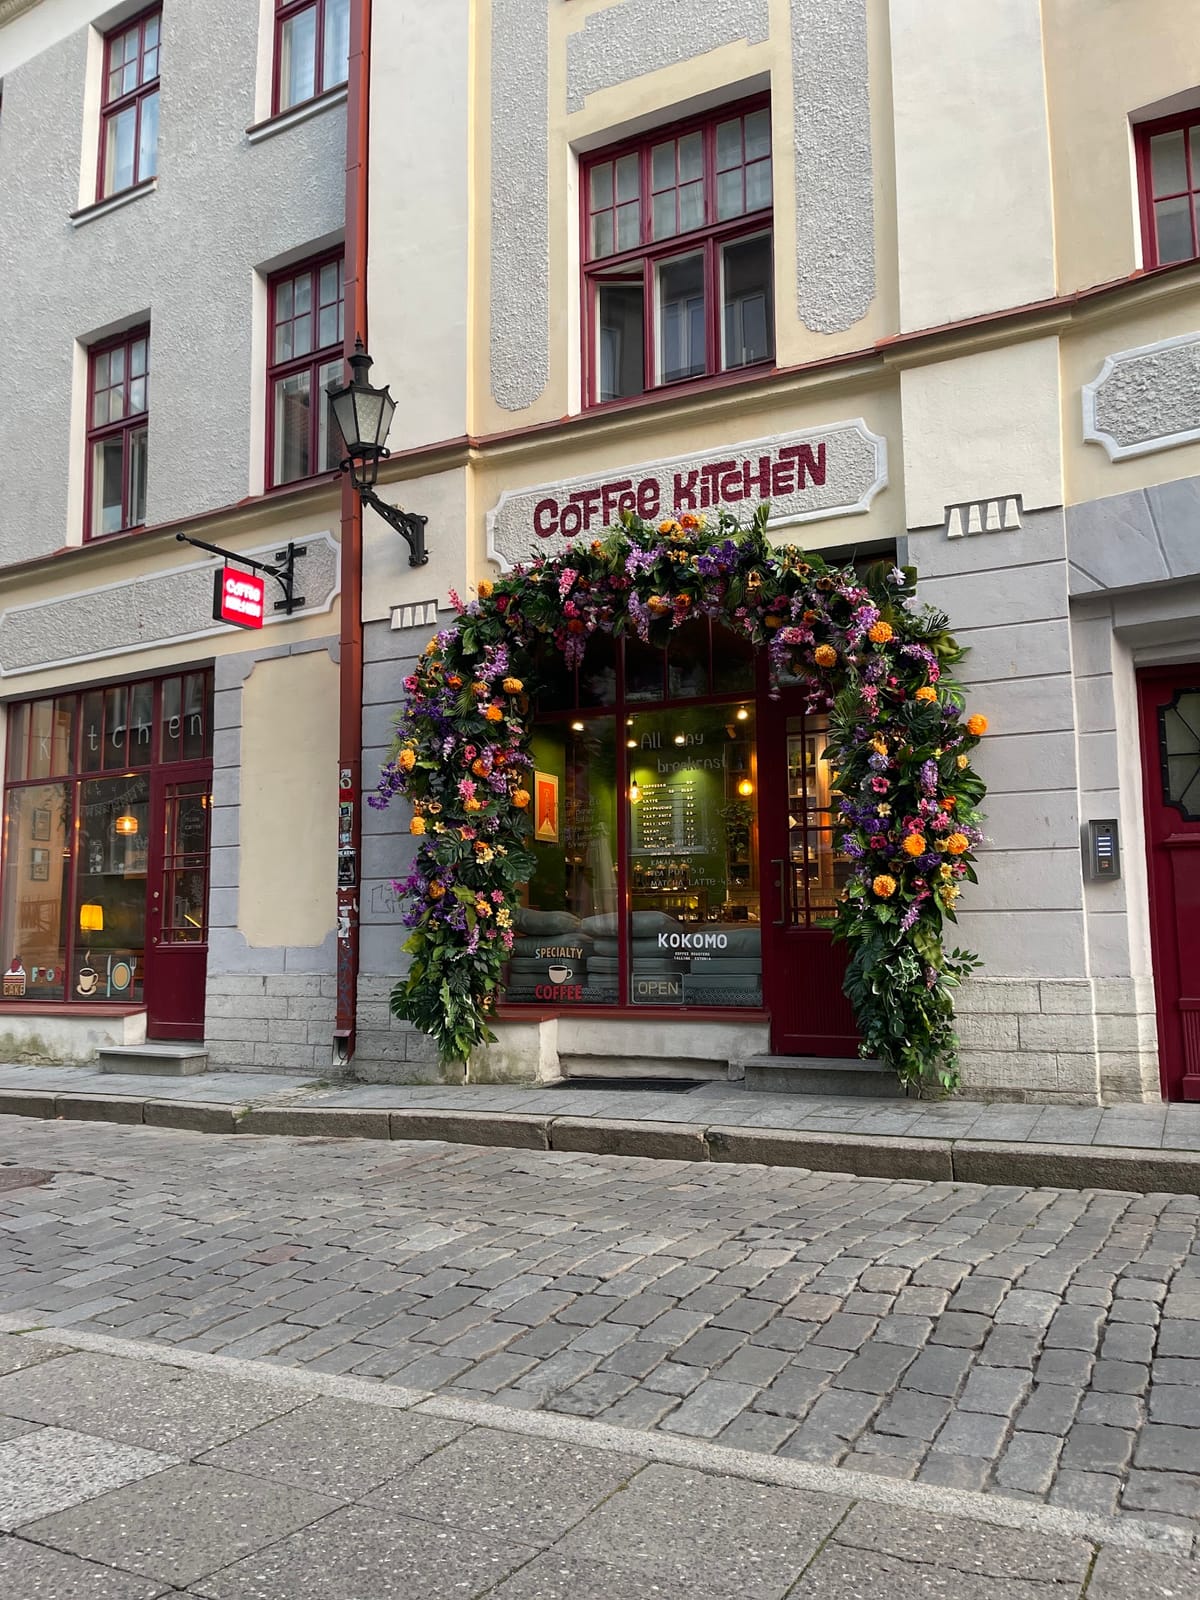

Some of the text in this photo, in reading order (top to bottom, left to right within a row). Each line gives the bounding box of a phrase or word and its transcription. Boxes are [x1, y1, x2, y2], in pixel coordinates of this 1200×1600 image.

[658, 933, 728, 949] KOKOMO
[535, 946, 583, 960] SPECIALTY
[3, 983, 25, 996] CAKE
[535, 984, 583, 1000] COFFEE
[638, 981, 679, 995] OPEN
